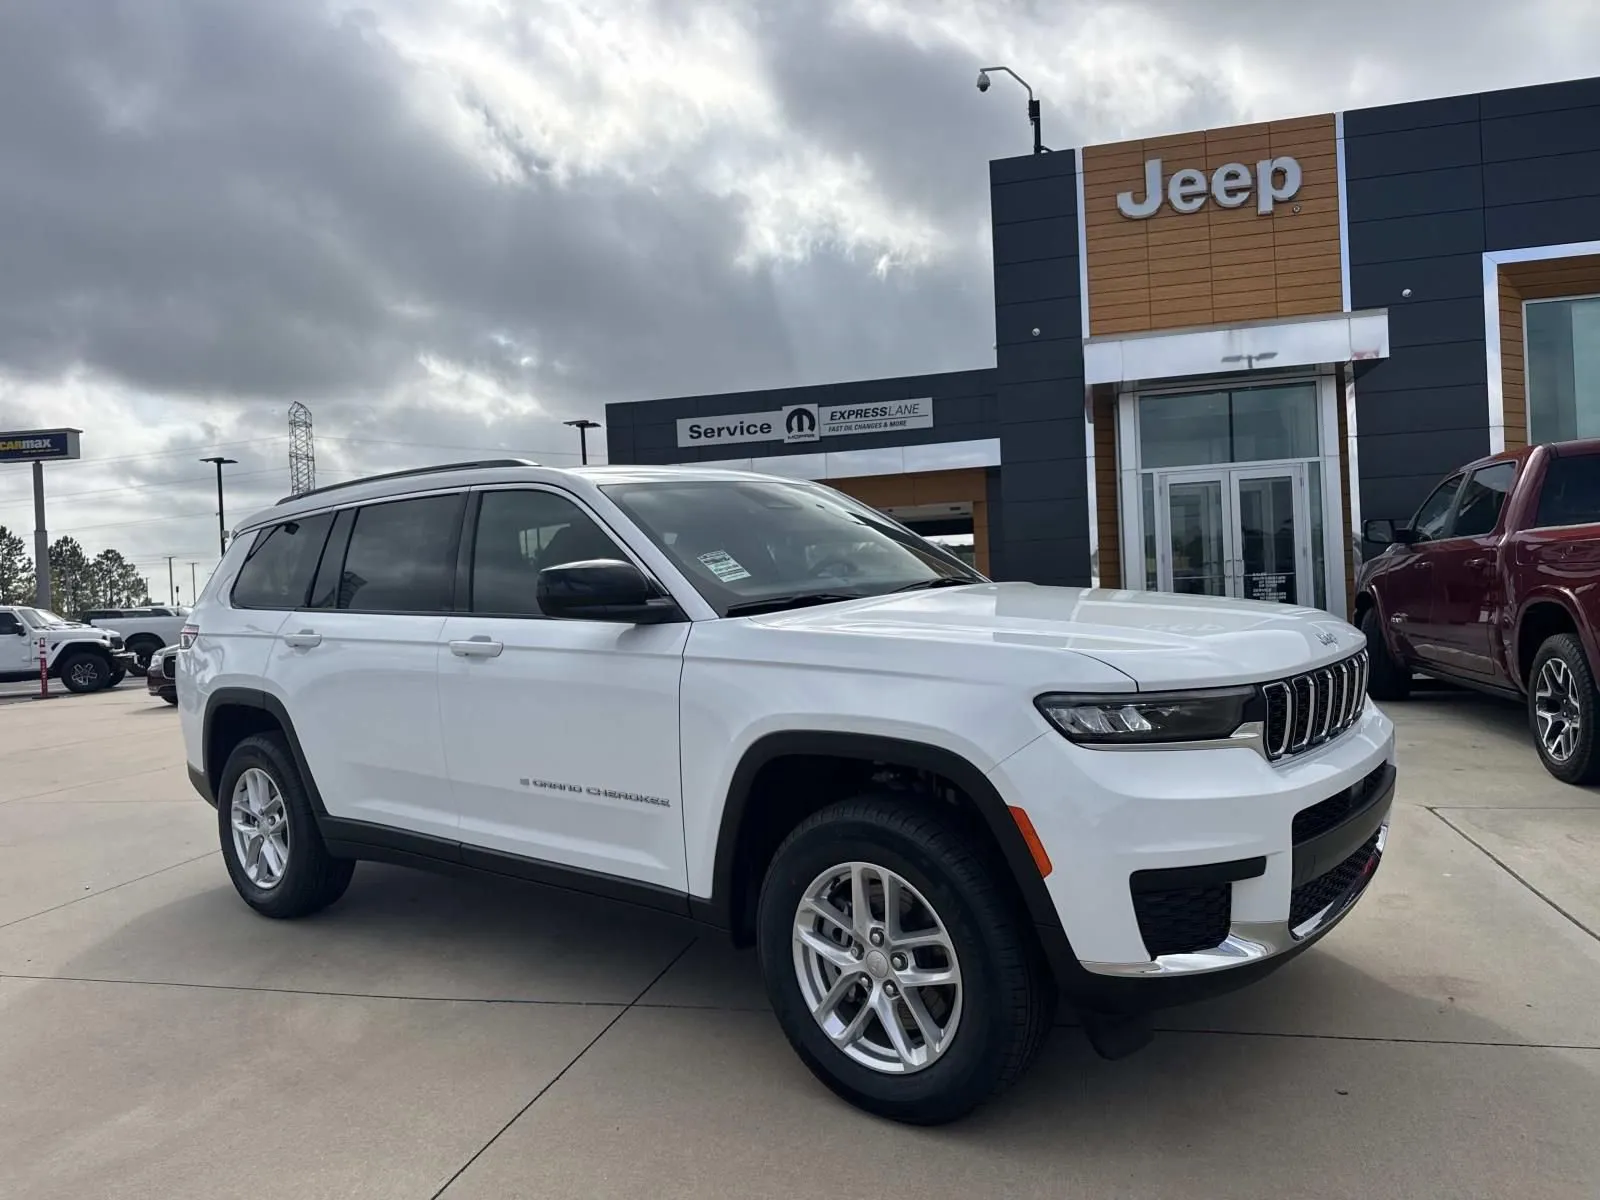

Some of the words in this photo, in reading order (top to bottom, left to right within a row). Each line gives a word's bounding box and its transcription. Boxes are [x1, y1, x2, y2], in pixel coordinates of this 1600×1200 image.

[1116, 156, 1302, 219] Jeep
[688, 420, 773, 440] Service
[828, 424, 844, 433] FAST
[854, 421, 882, 431] CHANGES
